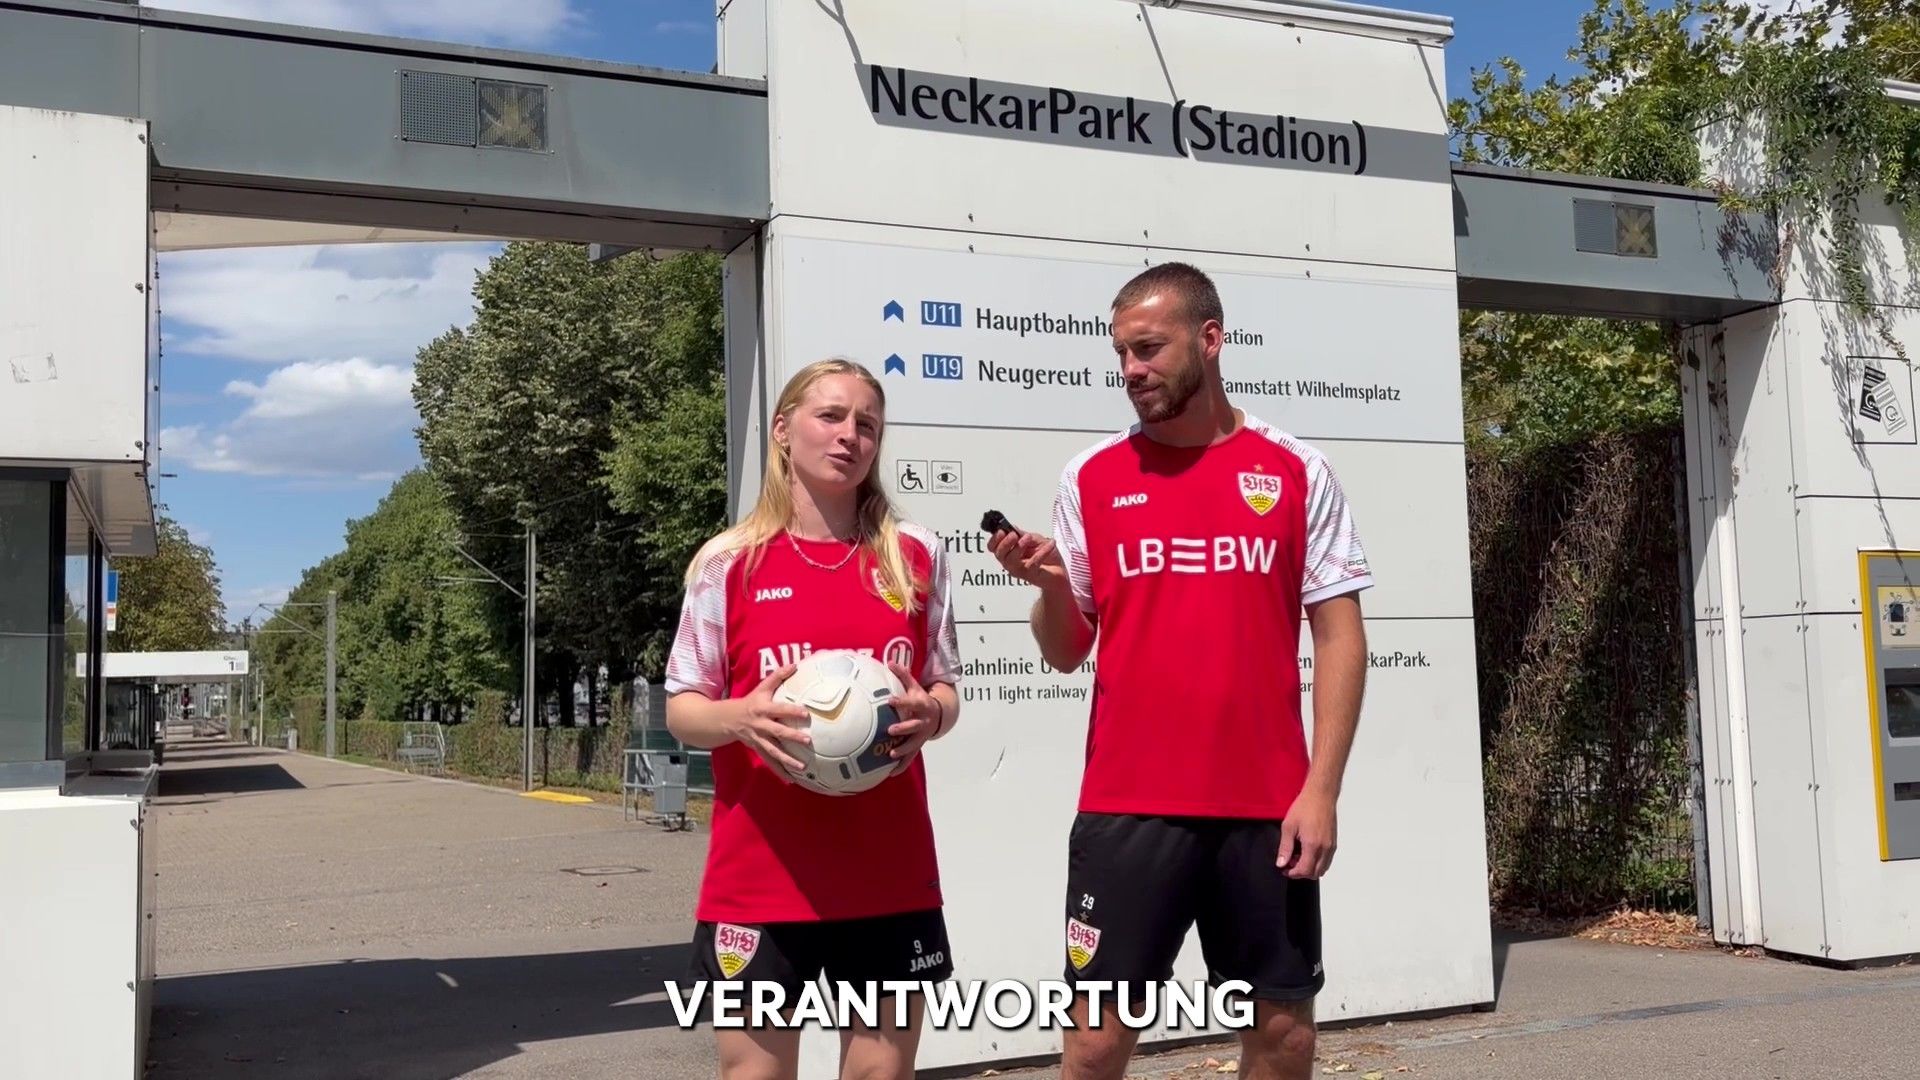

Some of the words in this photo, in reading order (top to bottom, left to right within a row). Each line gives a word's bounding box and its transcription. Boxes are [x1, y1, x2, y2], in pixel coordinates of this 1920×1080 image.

[870, 65, 1152, 145] NeckarPark
[1171, 99, 1368, 175] (Stadion)
[923, 303, 957, 325] U11
[1223, 328, 1263, 346] ation
[924, 356, 961, 378] U19
[978, 360, 1092, 389] Neugereut
[1105, 371, 1126, 389] üb
[1296, 380, 1400, 403] Wilhelmsplatz
[1112, 493, 1148, 508] JAKO
[755, 586, 793, 602] JAKO
[960, 657, 1034, 676] ahnlinie
[1367, 651, 1430, 668] karPark.
[998, 685, 1032, 704] light
[1037, 684, 1088, 702] railway
[1081, 893, 1095, 910] 29
[913, 939, 923, 954] 9
[910, 951, 944, 972] JAKO
